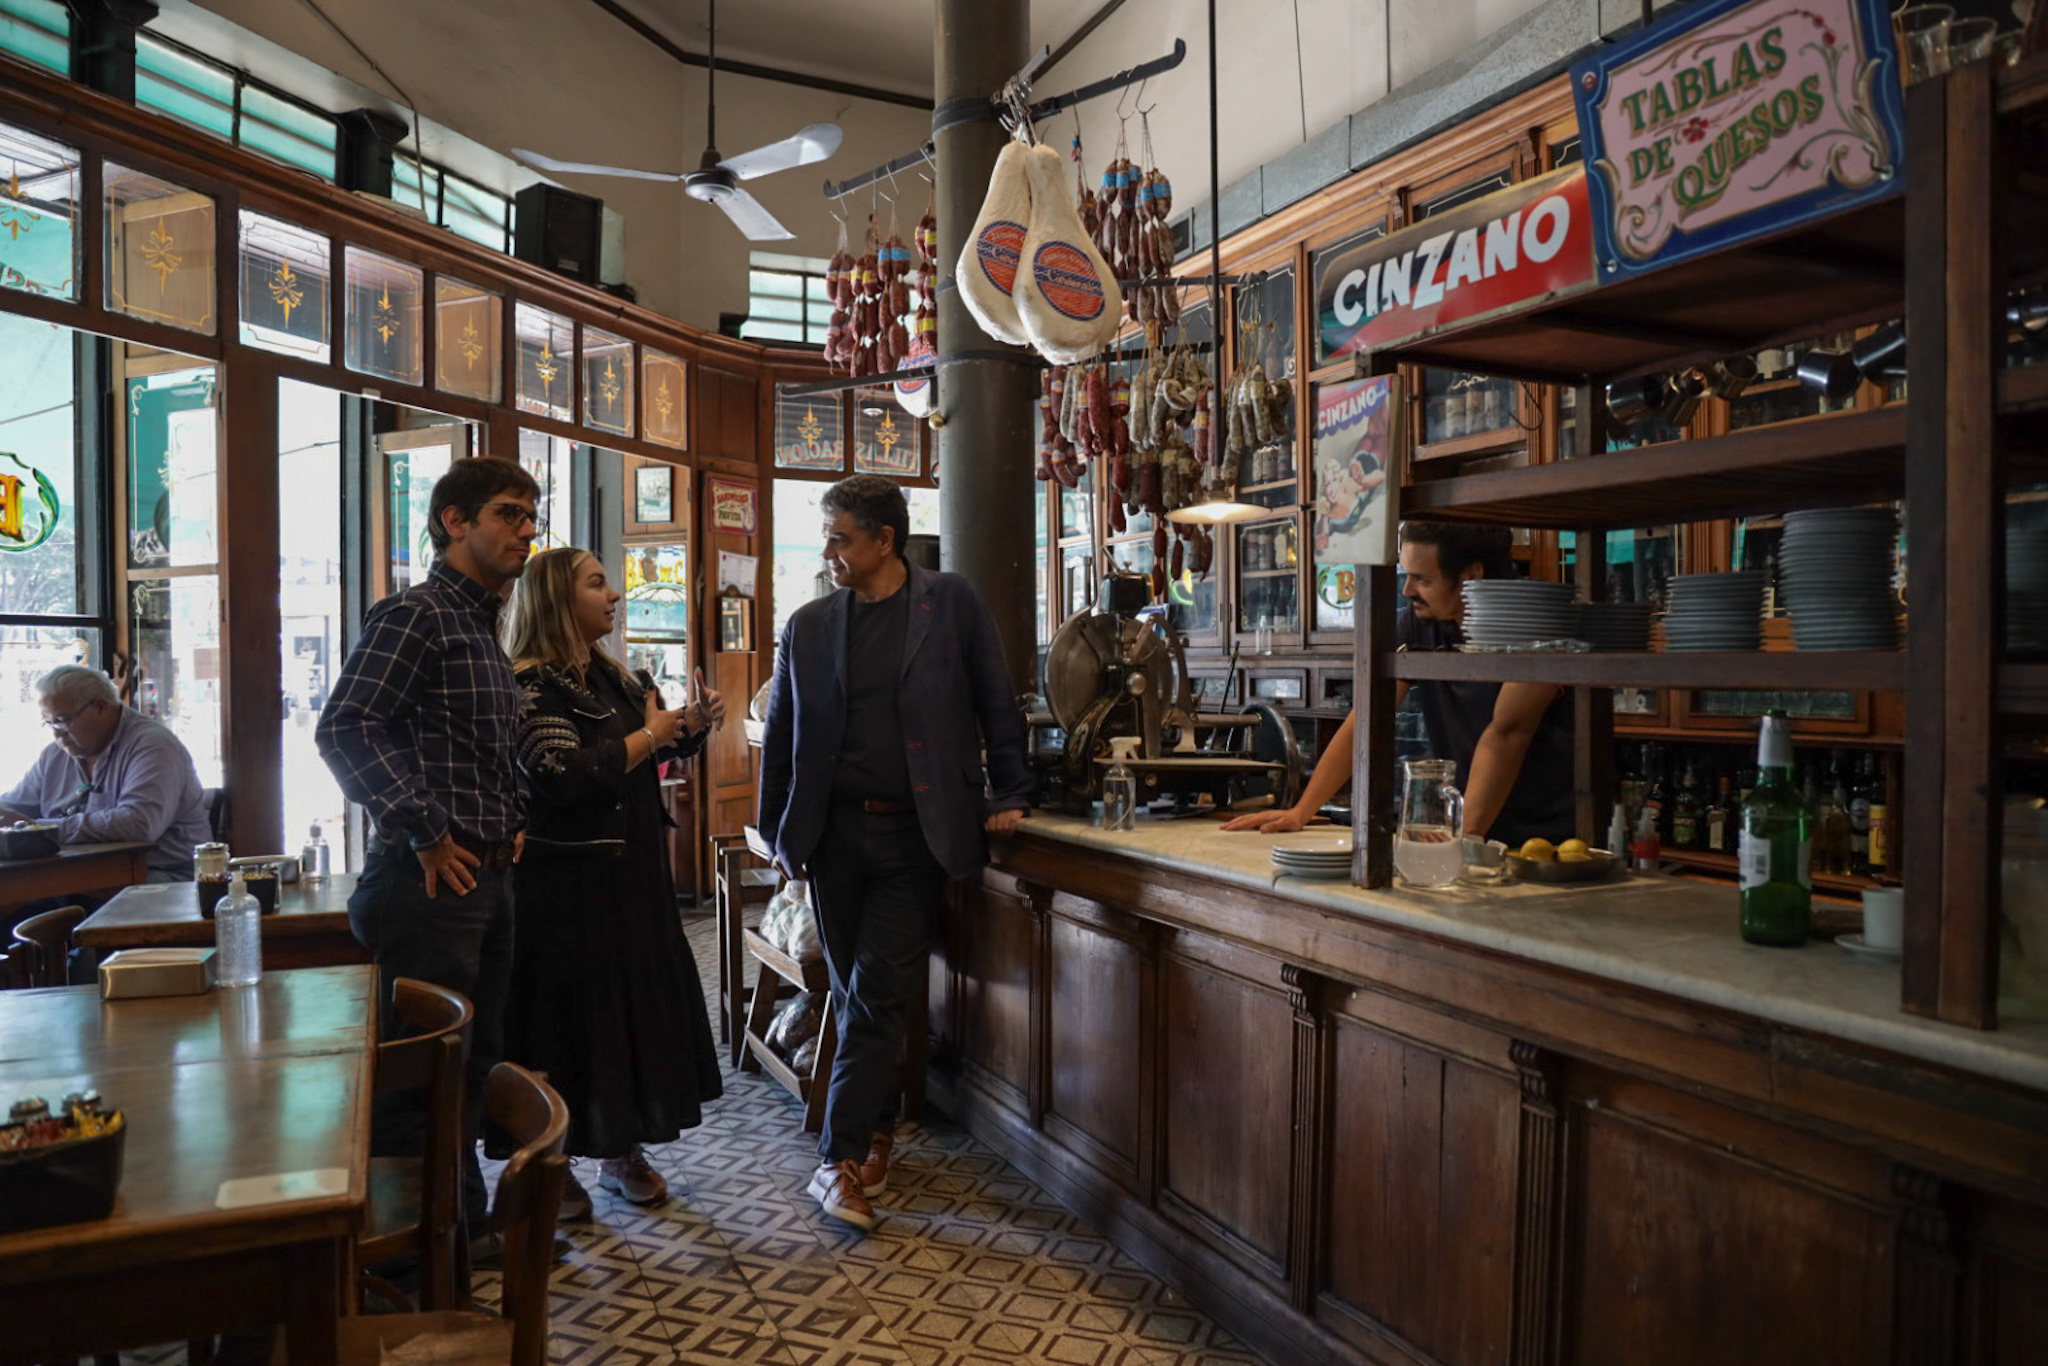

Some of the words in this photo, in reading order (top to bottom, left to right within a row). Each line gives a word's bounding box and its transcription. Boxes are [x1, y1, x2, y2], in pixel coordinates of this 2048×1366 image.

[1620, 27, 1787, 136] TABLAS
[1628, 137, 1675, 188] DE
[1673, 75, 1823, 214] QUESOS
[1333, 195, 1570, 326] CINZANO
[1317, 385, 1377, 431] CINZANO
